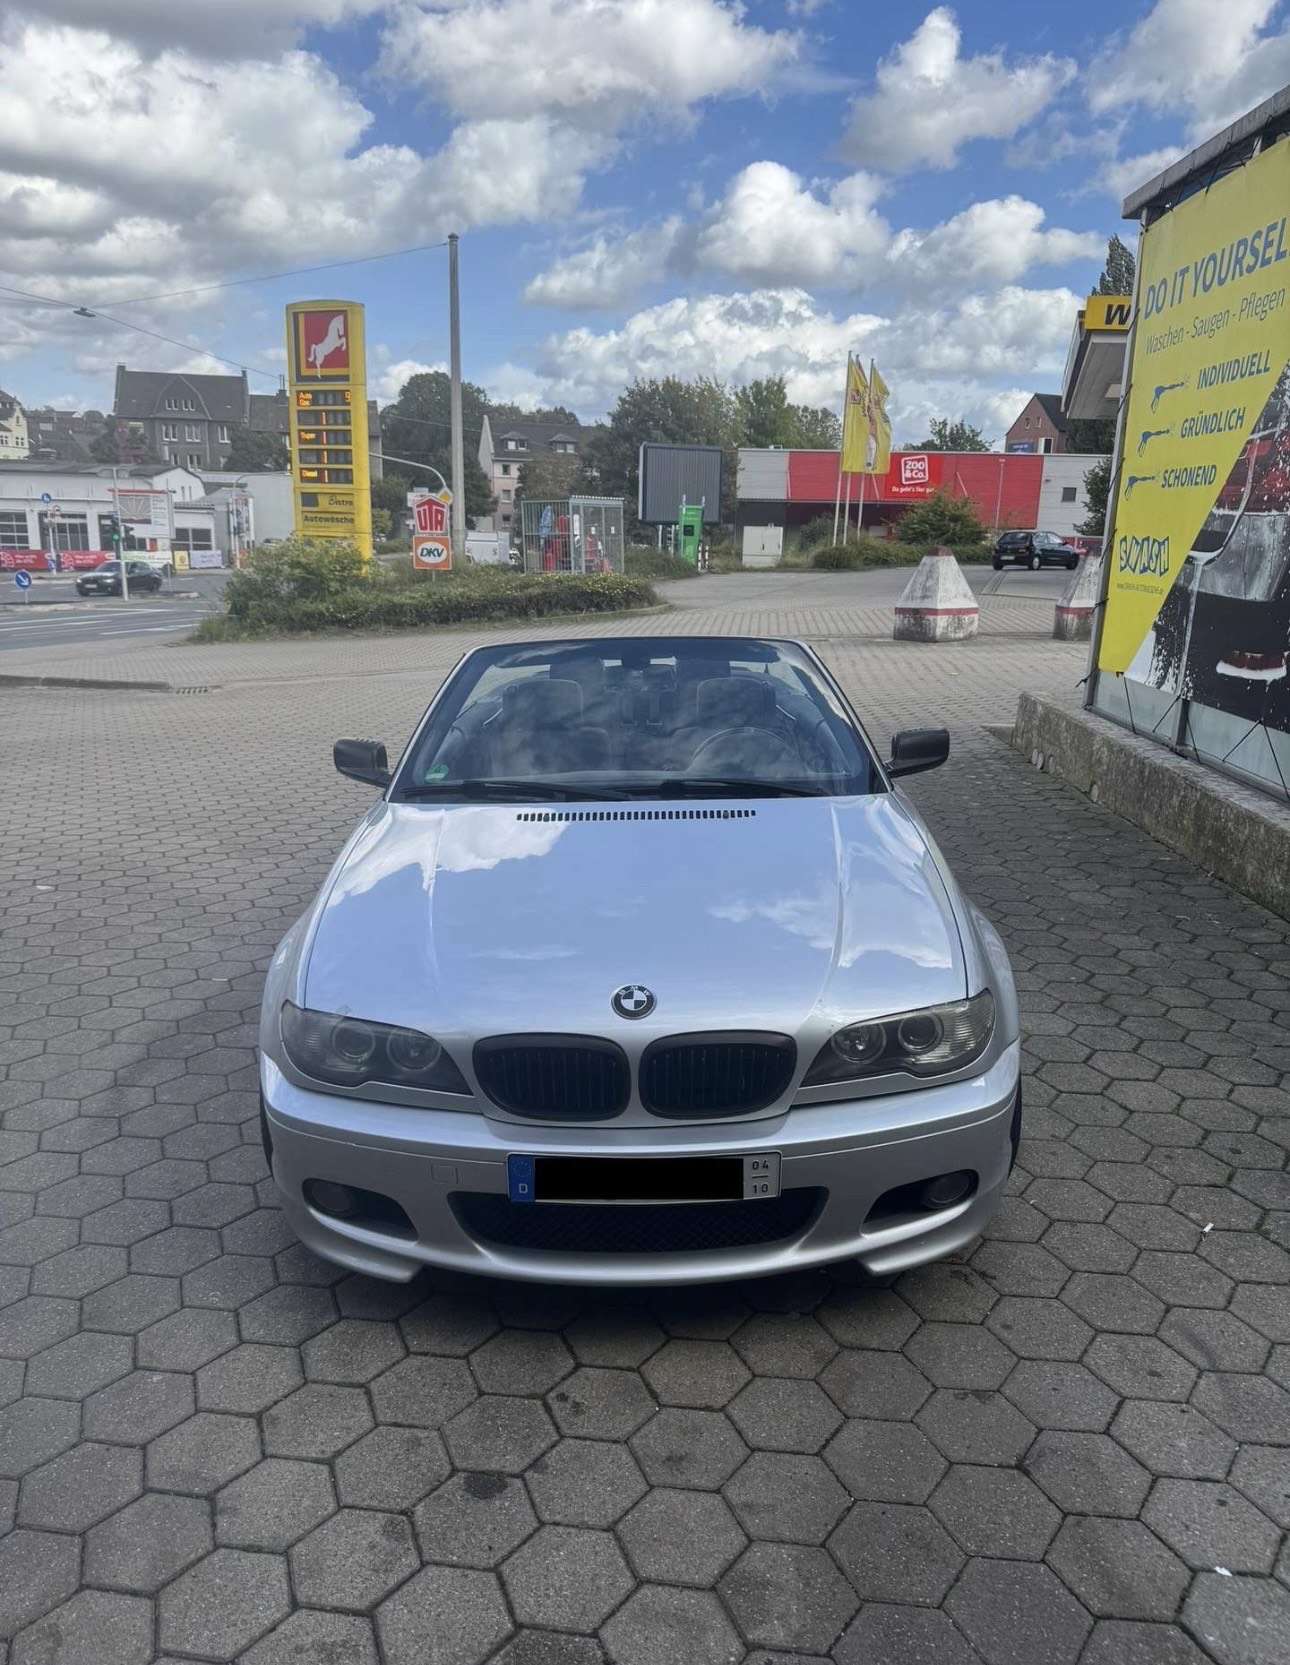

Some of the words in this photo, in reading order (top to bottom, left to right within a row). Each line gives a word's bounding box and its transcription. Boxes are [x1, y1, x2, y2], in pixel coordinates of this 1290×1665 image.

[1144, 278, 1168, 320] DO
[1170, 264, 1190, 308] IT
[1192, 217, 1290, 298] YOURSEL
[1146, 326, 1184, 356] Waschen
[1191, 309, 1231, 339] Saugen
[1239, 288, 1286, 322] Pflegen
[1197, 349, 1271, 390] INDIVIDUELL
[1181, 407, 1247, 440] GRÜNDLICH
[1161, 464, 1217, 489] SCHONEND
[416, 498, 446, 532] UTA
[420, 547, 445, 558] DKV
[752, 1159, 769, 1170] 04
[753, 1184, 768, 1194] 10
